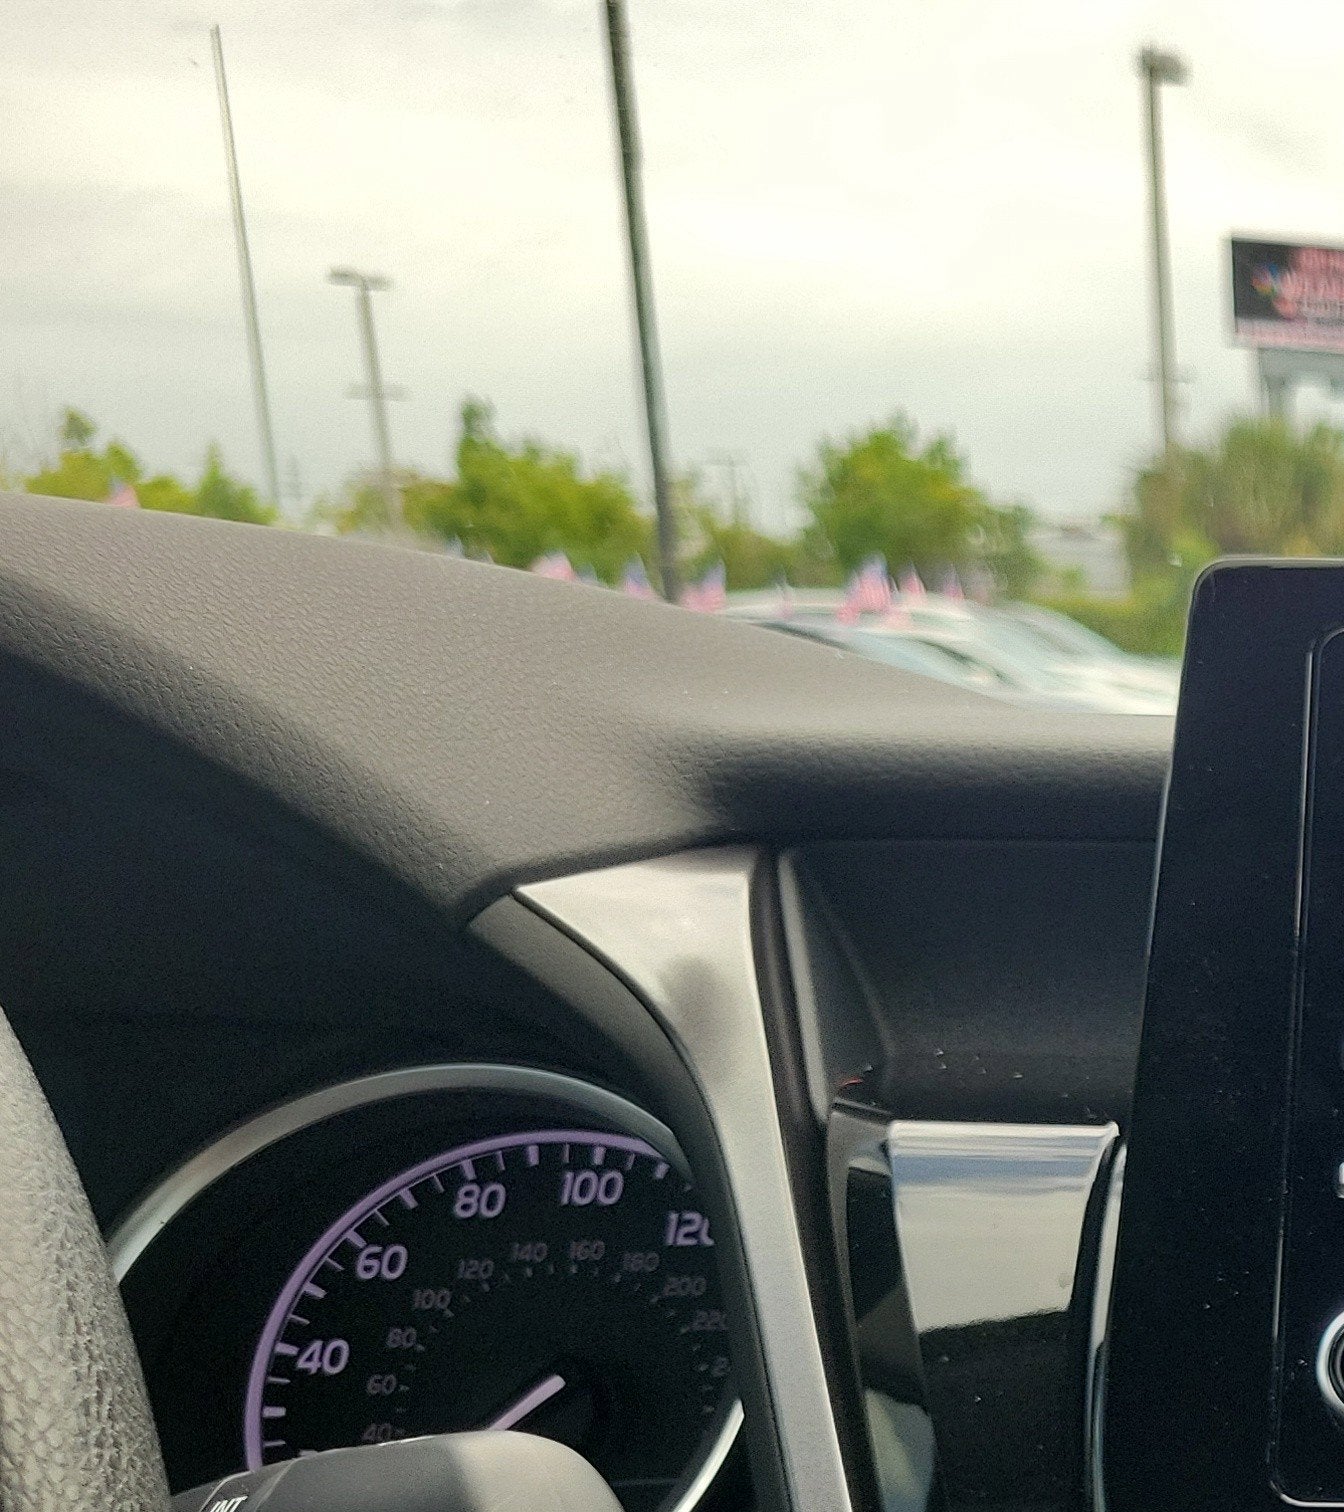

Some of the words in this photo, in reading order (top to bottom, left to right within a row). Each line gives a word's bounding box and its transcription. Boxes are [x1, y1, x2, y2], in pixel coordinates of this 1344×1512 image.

[453, 1181, 507, 1219] 80
[561, 1169, 625, 1207] 100
[355, 1245, 409, 1281] 60
[458, 1258, 495, 1281] 120
[412, 1288, 452, 1311] 100
[386, 1327, 418, 1349] 80
[298, 1338, 350, 1375] 40
[365, 1373, 398, 1396] 60
